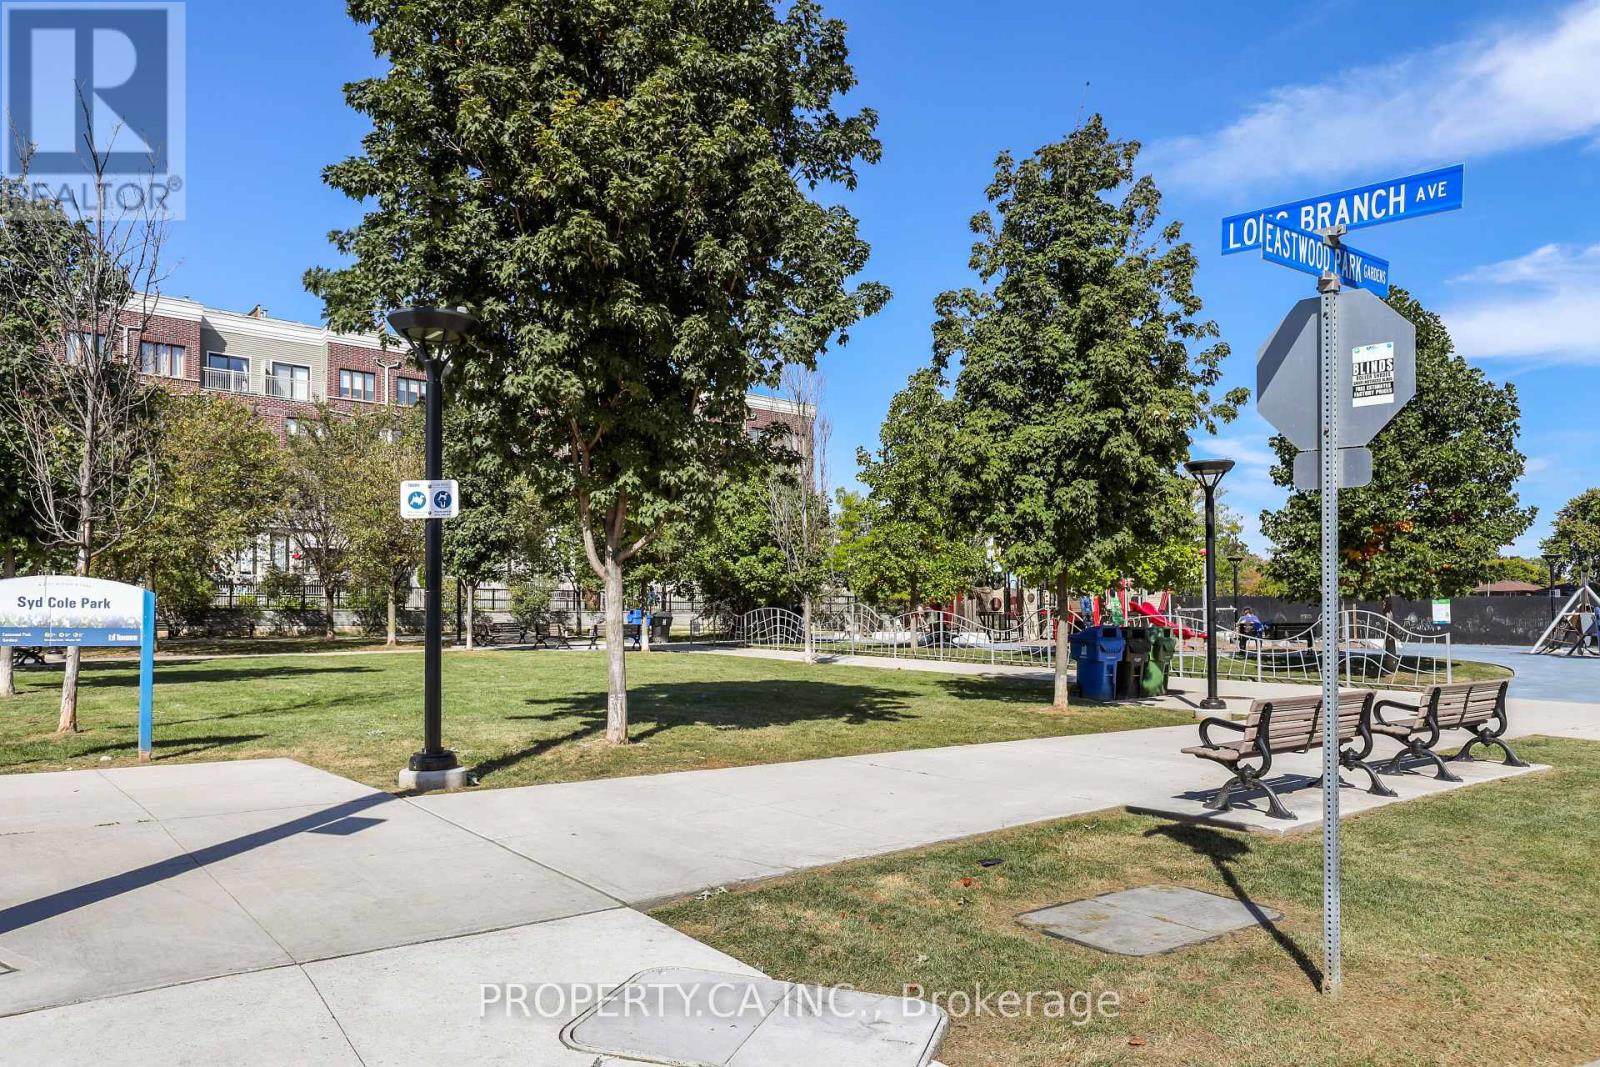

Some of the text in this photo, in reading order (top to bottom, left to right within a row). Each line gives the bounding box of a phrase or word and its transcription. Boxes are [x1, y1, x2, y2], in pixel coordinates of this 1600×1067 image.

[1300, 184, 1406, 232] BRANCH
[1416, 181, 1448, 203] AVE
[1266, 222, 1387, 285] EASTWOOD PARK GARDENS
[1353, 359, 1393, 375] BLINDS
[17, 596, 111, 611] Syd Cole Park
